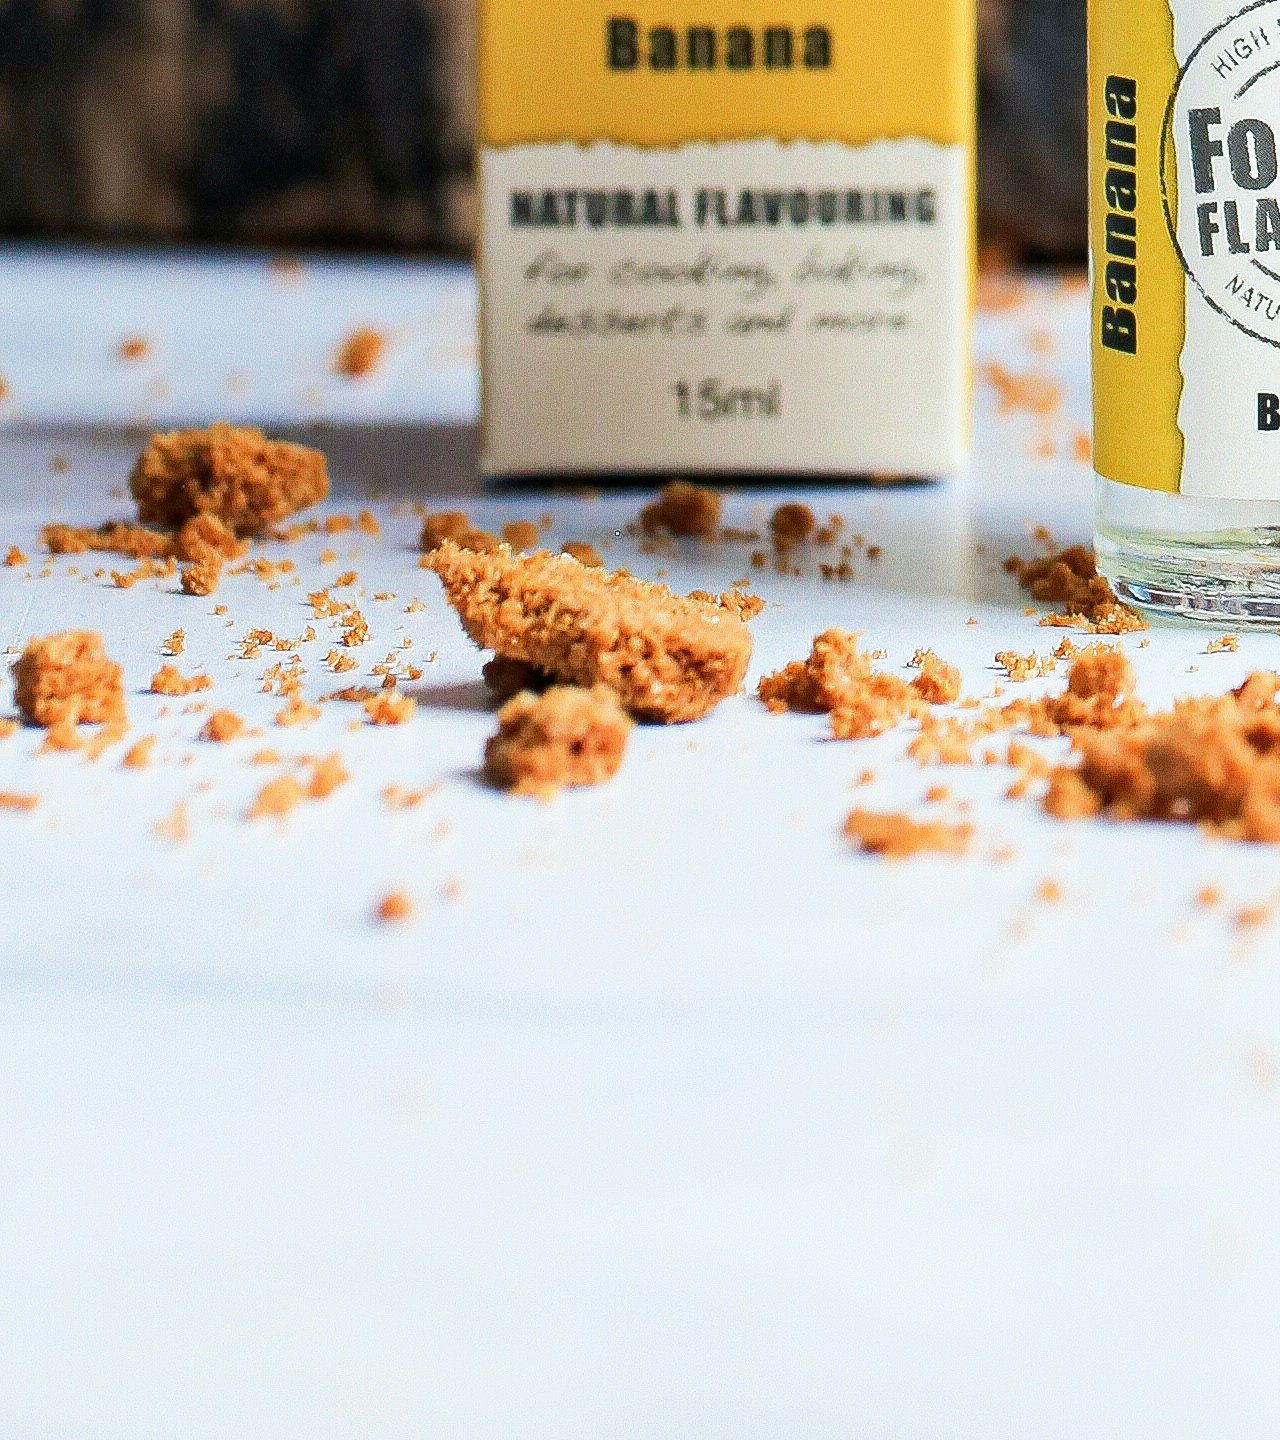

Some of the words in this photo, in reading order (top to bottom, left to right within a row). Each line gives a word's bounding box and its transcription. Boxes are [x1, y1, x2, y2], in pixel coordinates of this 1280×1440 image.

[606, 16, 834, 71] Banana
[1209, 26, 1271, 79] HIGH
[509, 187, 681, 228] NATURAL
[694, 186, 938, 228] FLAVOURING
[1101, 74, 1137, 356] Banana
[674, 377, 783, 421] 15ml
